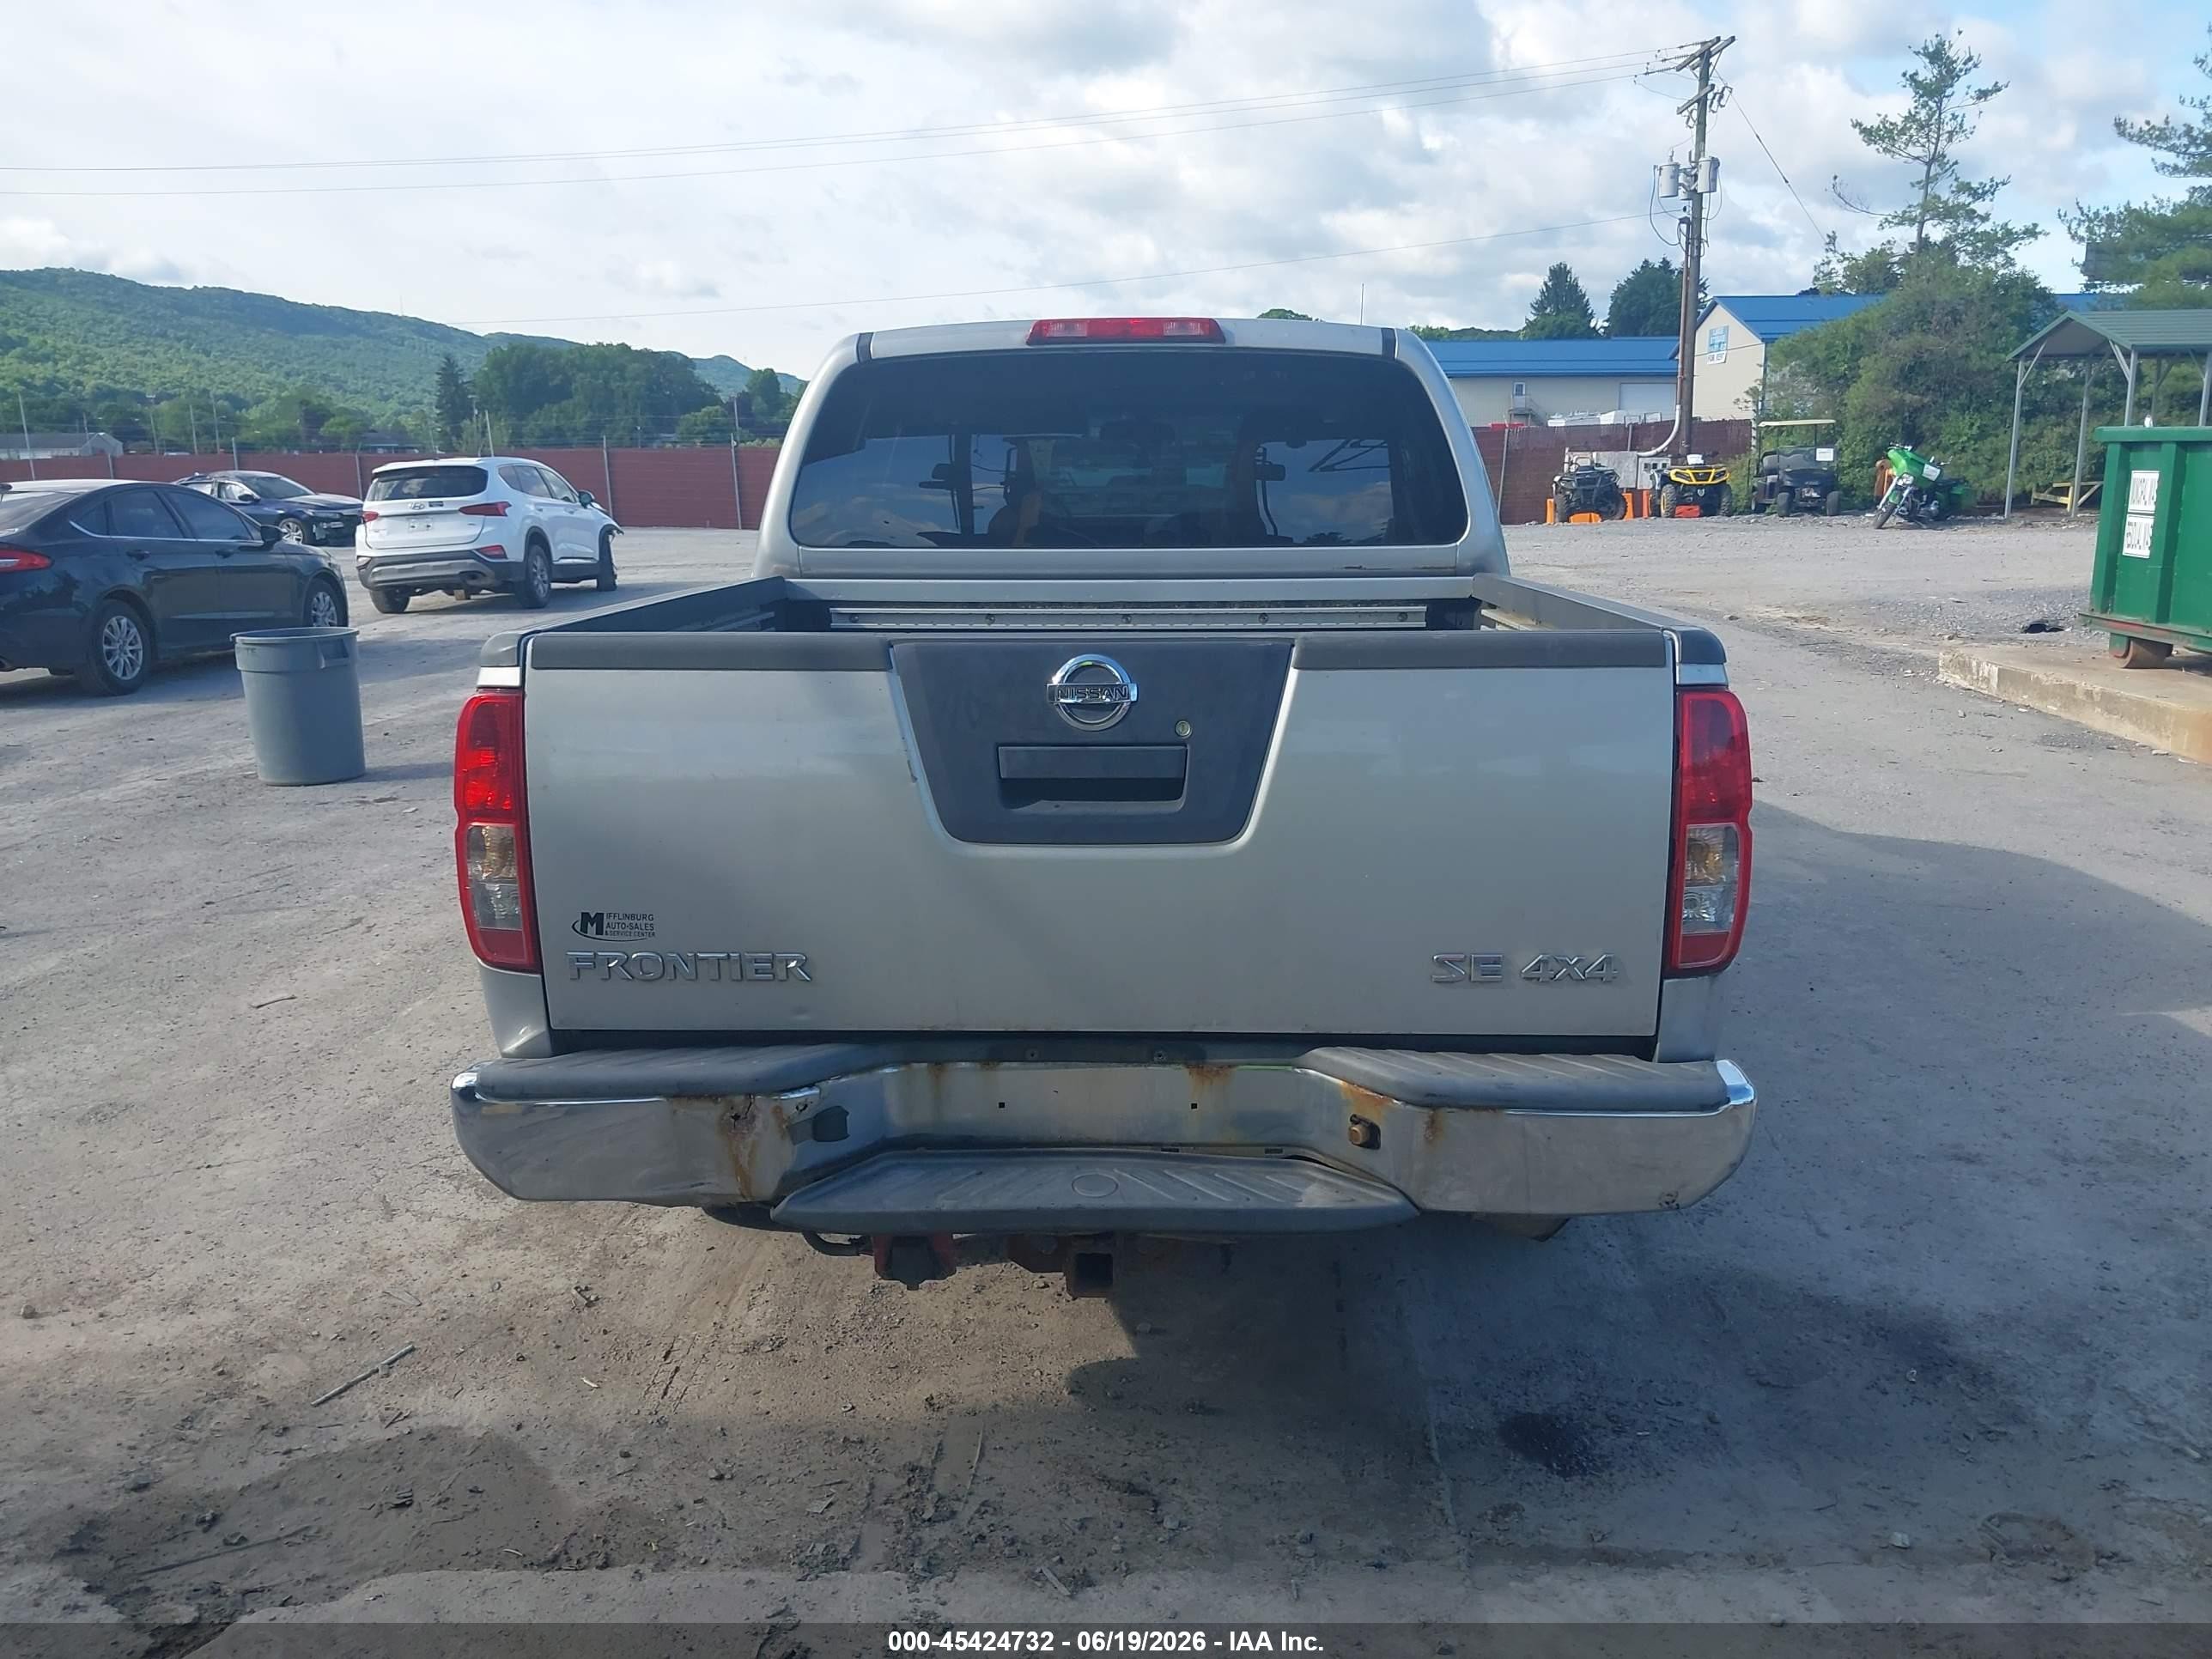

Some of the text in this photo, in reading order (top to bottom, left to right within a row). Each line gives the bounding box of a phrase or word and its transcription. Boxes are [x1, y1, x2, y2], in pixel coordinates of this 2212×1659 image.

[1057, 686, 1128, 700] NISSAN
[606, 922, 654, 931] AUTO-SALES
[566, 951, 811, 981] FRONTIER
[1431, 954, 1503, 982] SE
